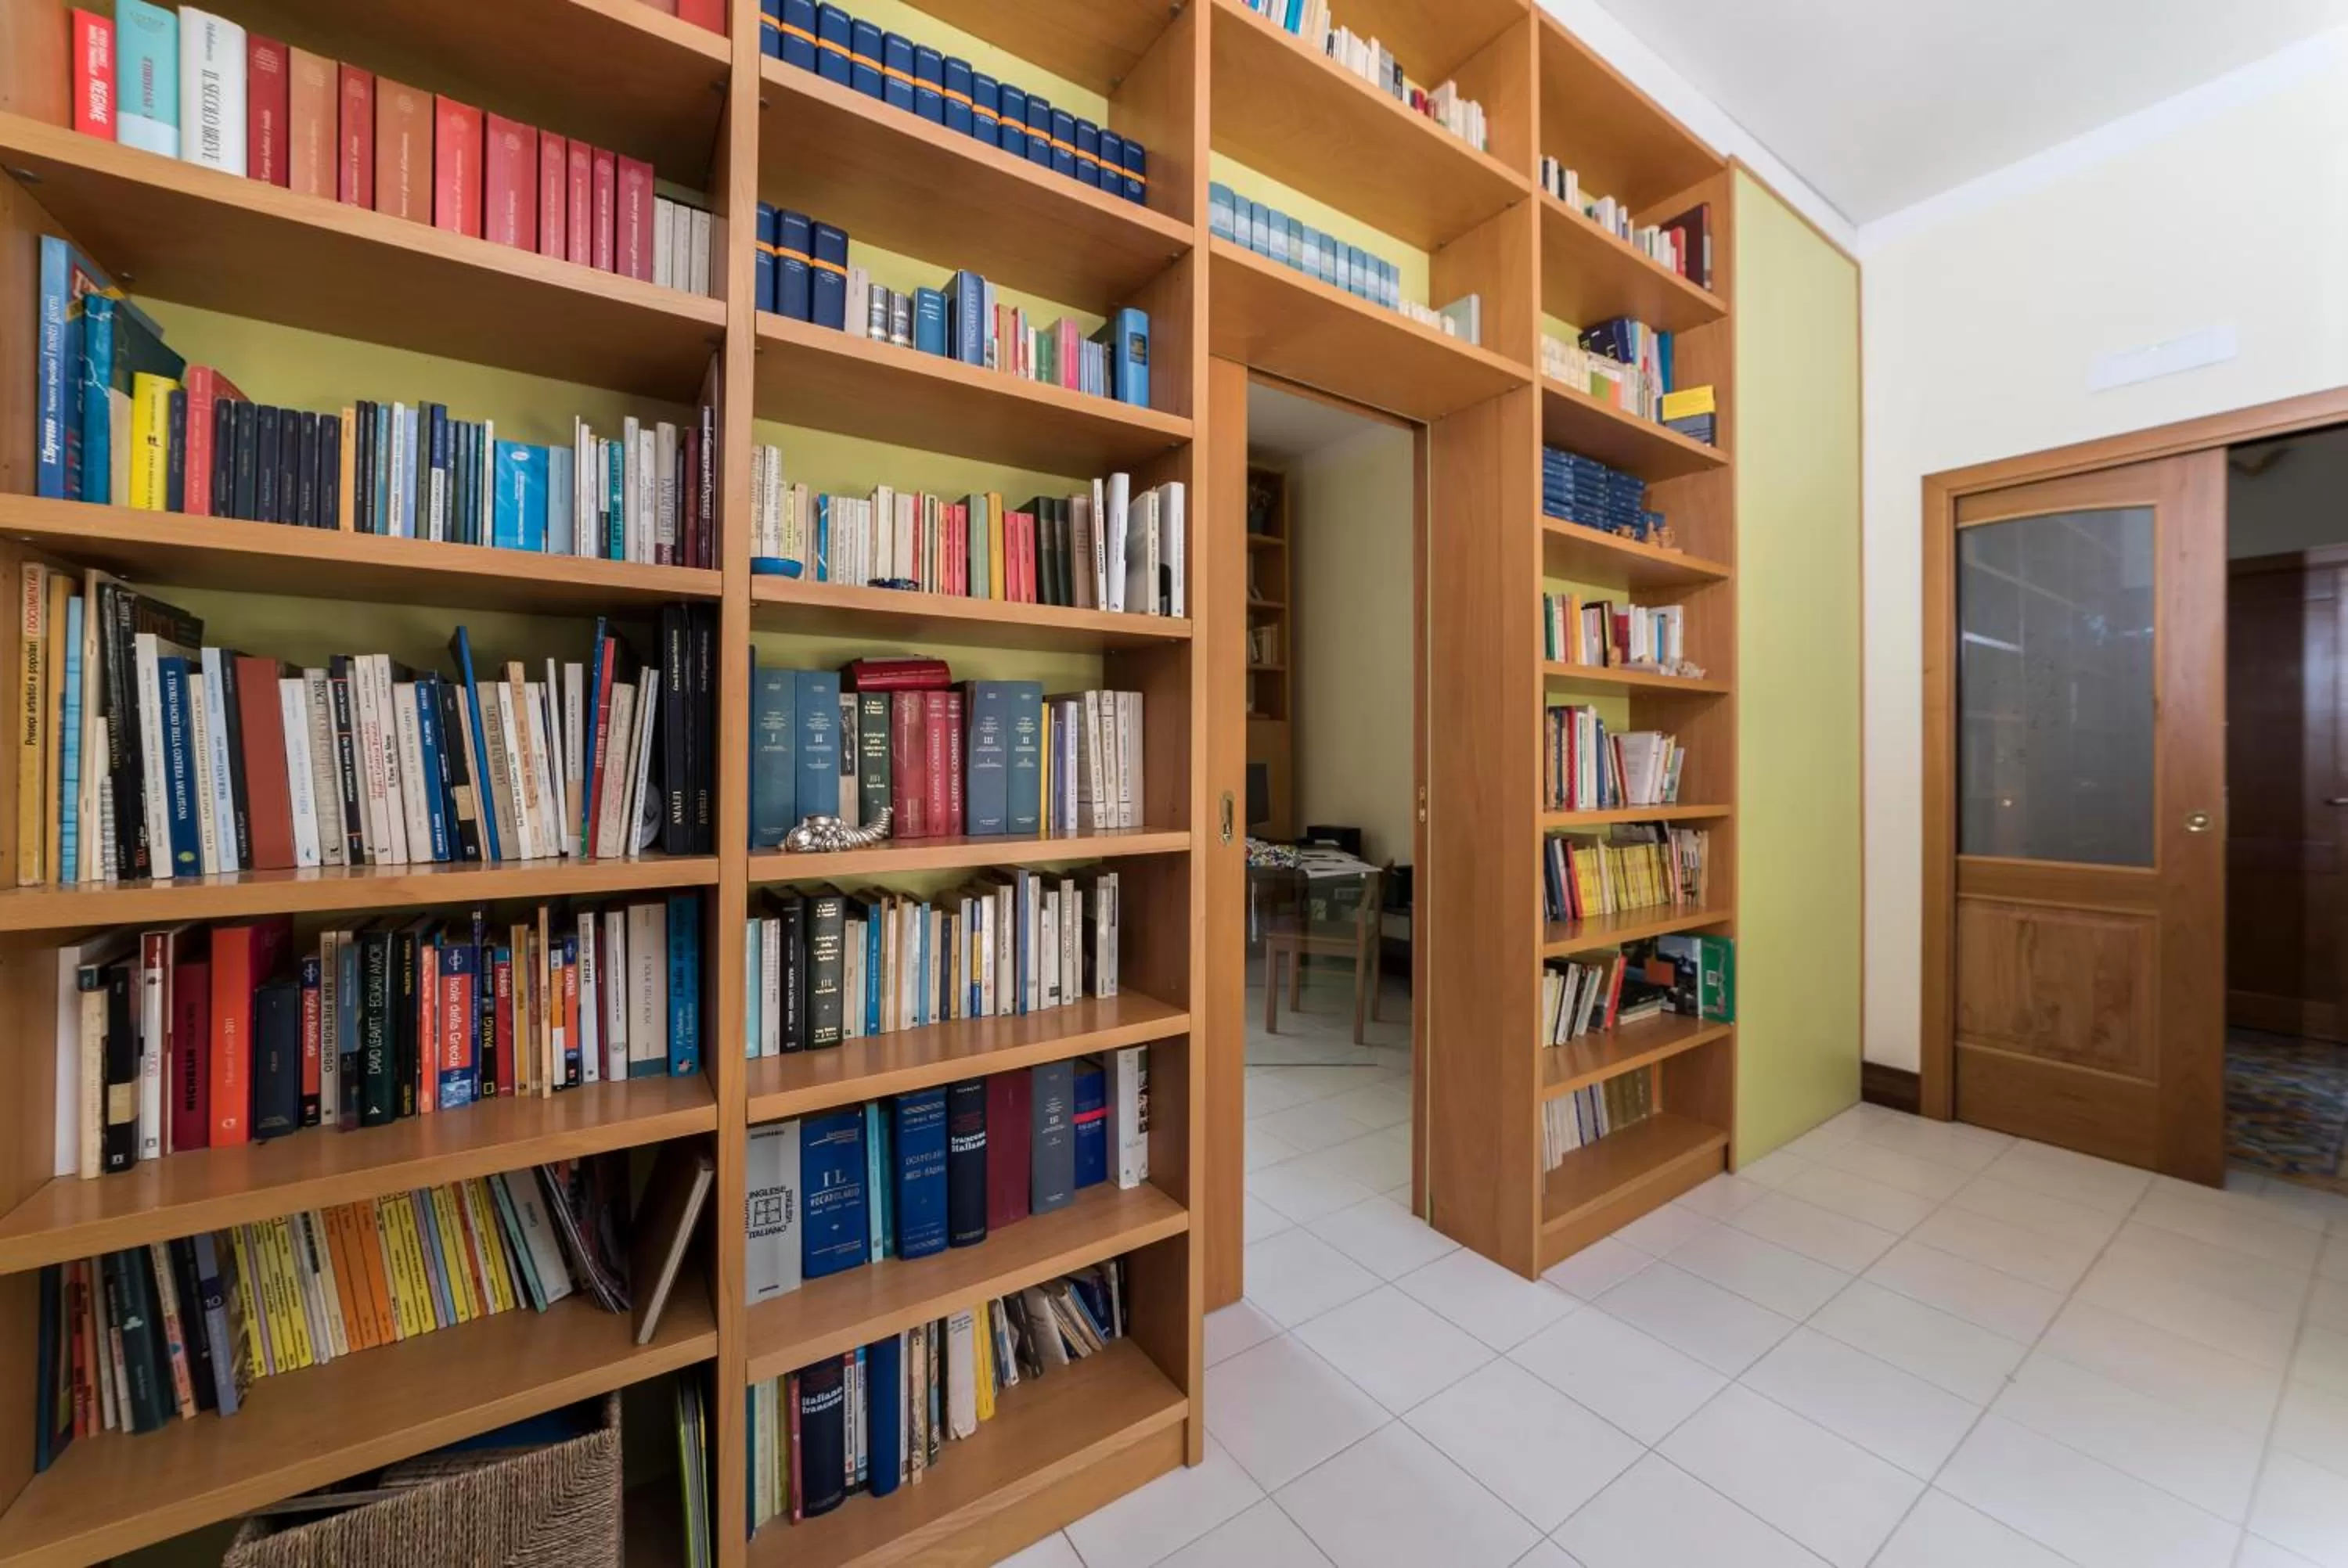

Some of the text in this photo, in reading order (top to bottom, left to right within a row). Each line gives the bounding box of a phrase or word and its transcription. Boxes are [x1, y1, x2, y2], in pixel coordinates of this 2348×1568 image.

[26, 641, 38, 674] popolari
[26, 683, 36, 714] artistici
[25, 717, 38, 746] Presepi
[672, 791, 682, 825] AMALFI
[367, 944, 384, 1076] DAVID LEAVITT EGUALI AMORI
[449, 977, 463, 1067] Isole della Grecia
[324, 981, 335, 1073] SAN PIETROBURGO
[483, 1016, 495, 1048] PARIGI
[749, 1185, 787, 1199] INGLESE
[749, 1224, 787, 1239] ITALIANO
[206, 1295, 223, 1309] 10
[801, 1386, 844, 1406] italiano
[801, 1394, 844, 1415] francese
